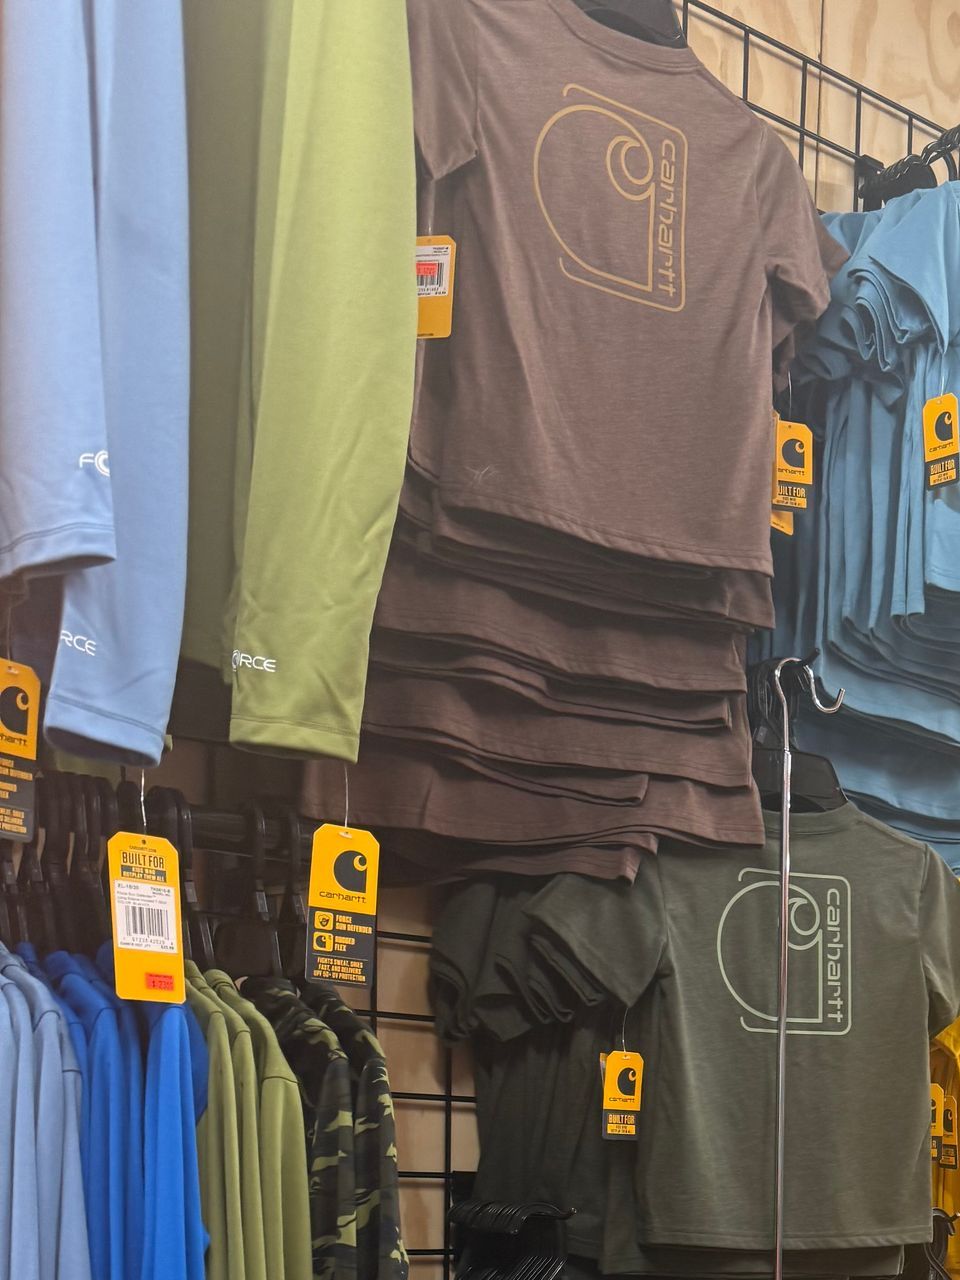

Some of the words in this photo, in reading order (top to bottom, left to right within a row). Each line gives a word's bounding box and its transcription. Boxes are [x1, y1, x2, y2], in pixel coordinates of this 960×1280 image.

[659, 139, 677, 296] carhartt
[777, 467, 804, 476] arhartt
[777, 484, 792, 496] UILT
[793, 487, 805, 498] FOR
[60, 630, 96, 657] RCE
[122, 851, 146, 867] BUILT
[148, 855, 164, 869] FOR
[319, 891, 366, 904] carhartt
[827, 888, 843, 1023] carhartt
[608, 1114, 624, 1125] BUILT
[624, 1115, 635, 1125] FOR
